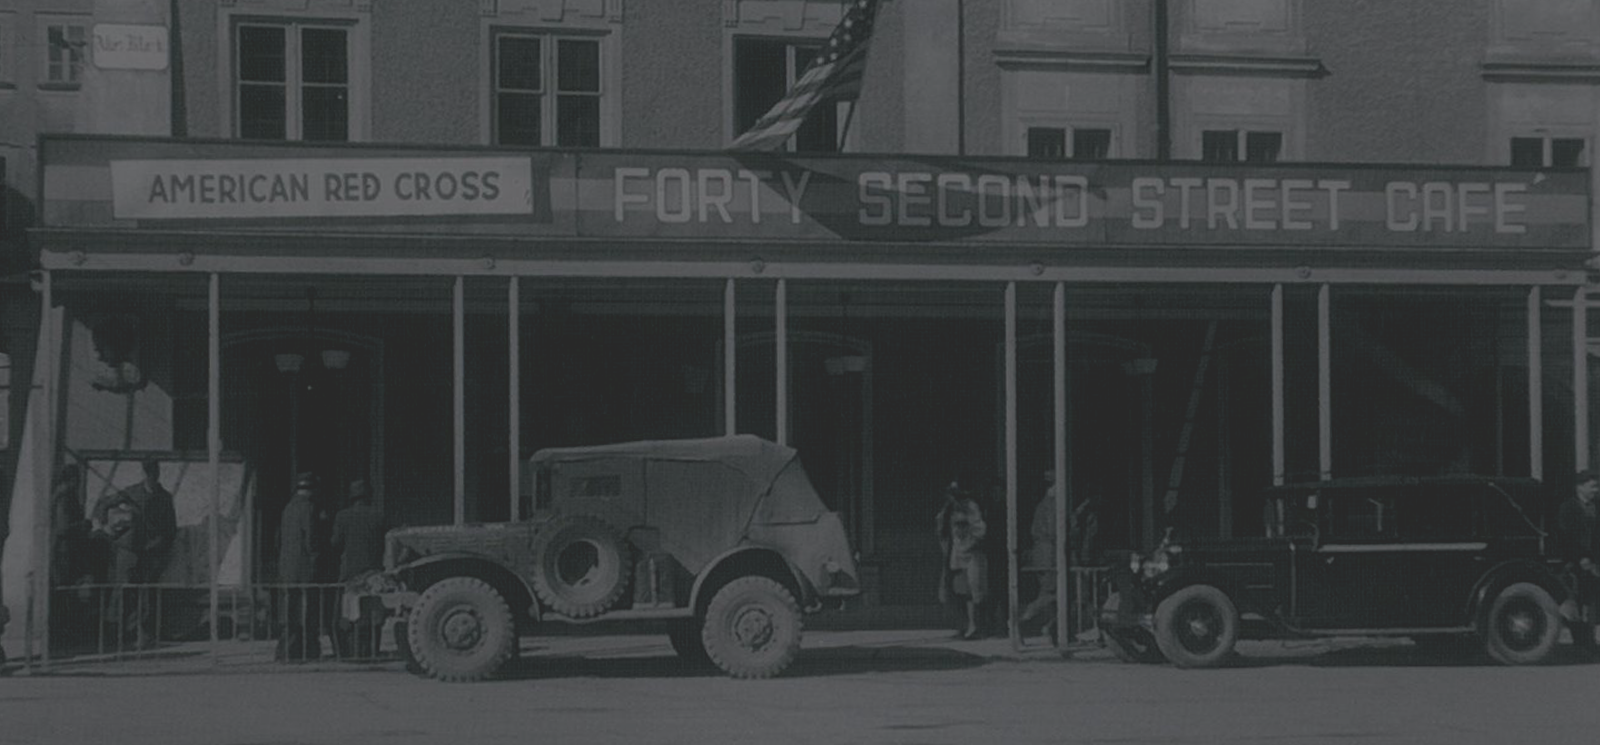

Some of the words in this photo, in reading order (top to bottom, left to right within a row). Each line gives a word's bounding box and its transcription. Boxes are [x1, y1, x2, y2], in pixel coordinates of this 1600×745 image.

[148, 174, 309, 204] AMERICAN
[324, 173, 381, 202] RED
[395, 172, 501, 201] CROSS
[613, 167, 810, 224] FORTY
[858, 171, 1088, 228] SECOND
[1131, 177, 1351, 231] STREET
